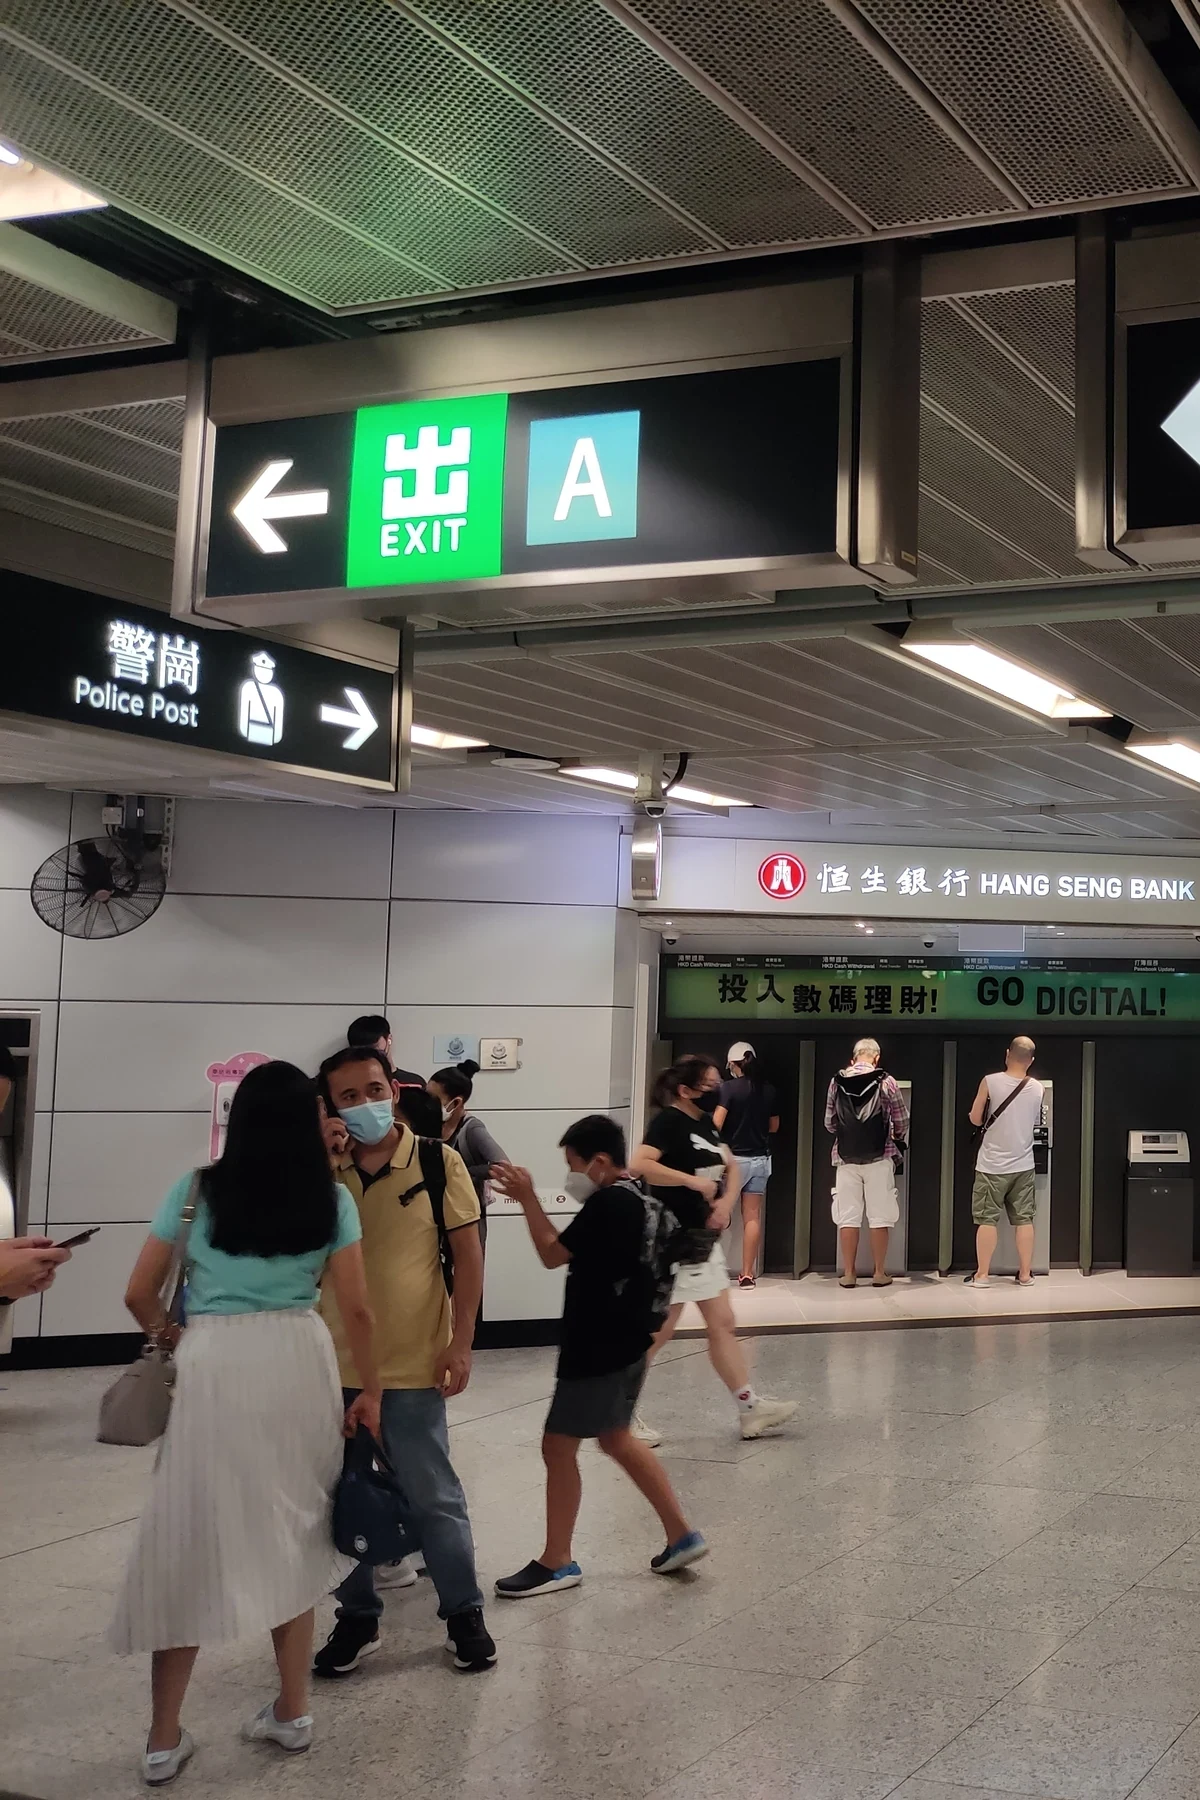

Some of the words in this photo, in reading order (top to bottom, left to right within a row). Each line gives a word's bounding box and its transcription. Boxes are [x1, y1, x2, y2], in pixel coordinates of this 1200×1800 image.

[382, 425, 471, 519] 出
[553, 437, 613, 522] A
[380, 517, 468, 558] EXIT
[107, 619, 201, 694] 警崗
[75, 675, 144, 717] Police
[151, 692, 200, 729] Post
[816, 862, 971, 898] 恒生銀行
[980, 873, 1051, 897] HANG
[1057, 876, 1123, 900] SENG
[1130, 878, 1196, 902] BANK
[718, 973, 938, 1015] 投入數碼理財!
[976, 976, 1025, 1007] GO
[1036, 986, 1168, 1016] DIGITAL!
